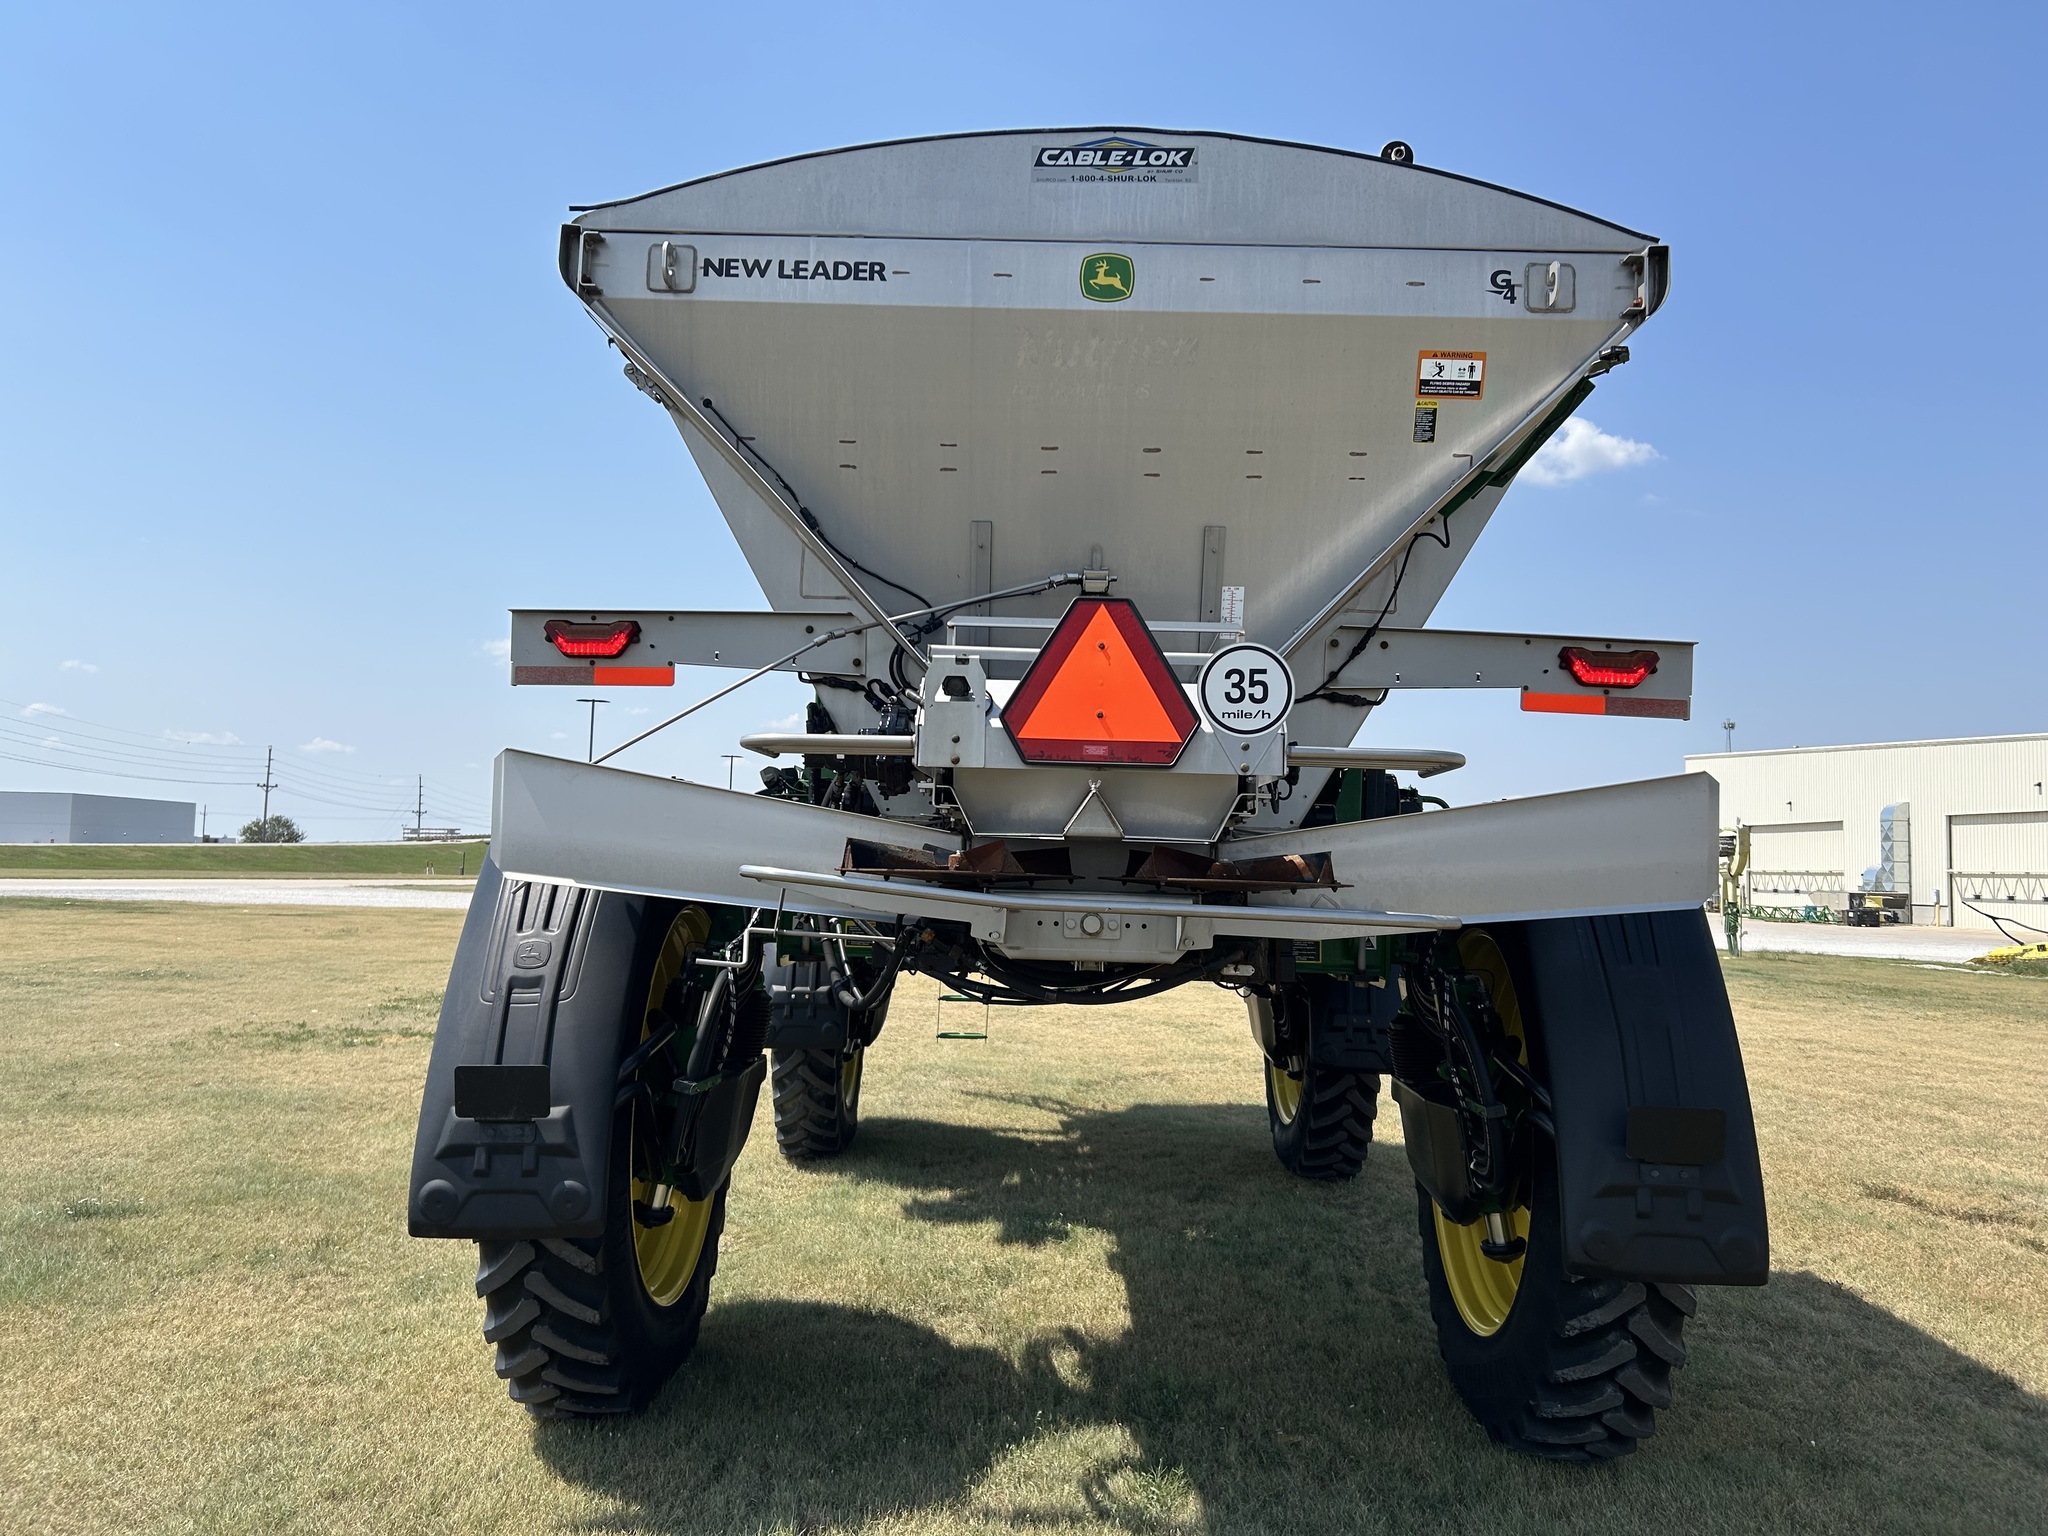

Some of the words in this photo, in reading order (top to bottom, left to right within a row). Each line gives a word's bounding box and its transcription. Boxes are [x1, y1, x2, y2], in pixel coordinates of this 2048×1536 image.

[1041, 150, 1188, 166] CABLE-LOK
[1070, 175, 1157, 183] 1-800-4-SHUR-LOK
[703, 258, 773, 279] NEW
[777, 259, 887, 282] LEADER
[1224, 668, 1269, 705] 35
[1221, 709, 1271, 719] mile/h
